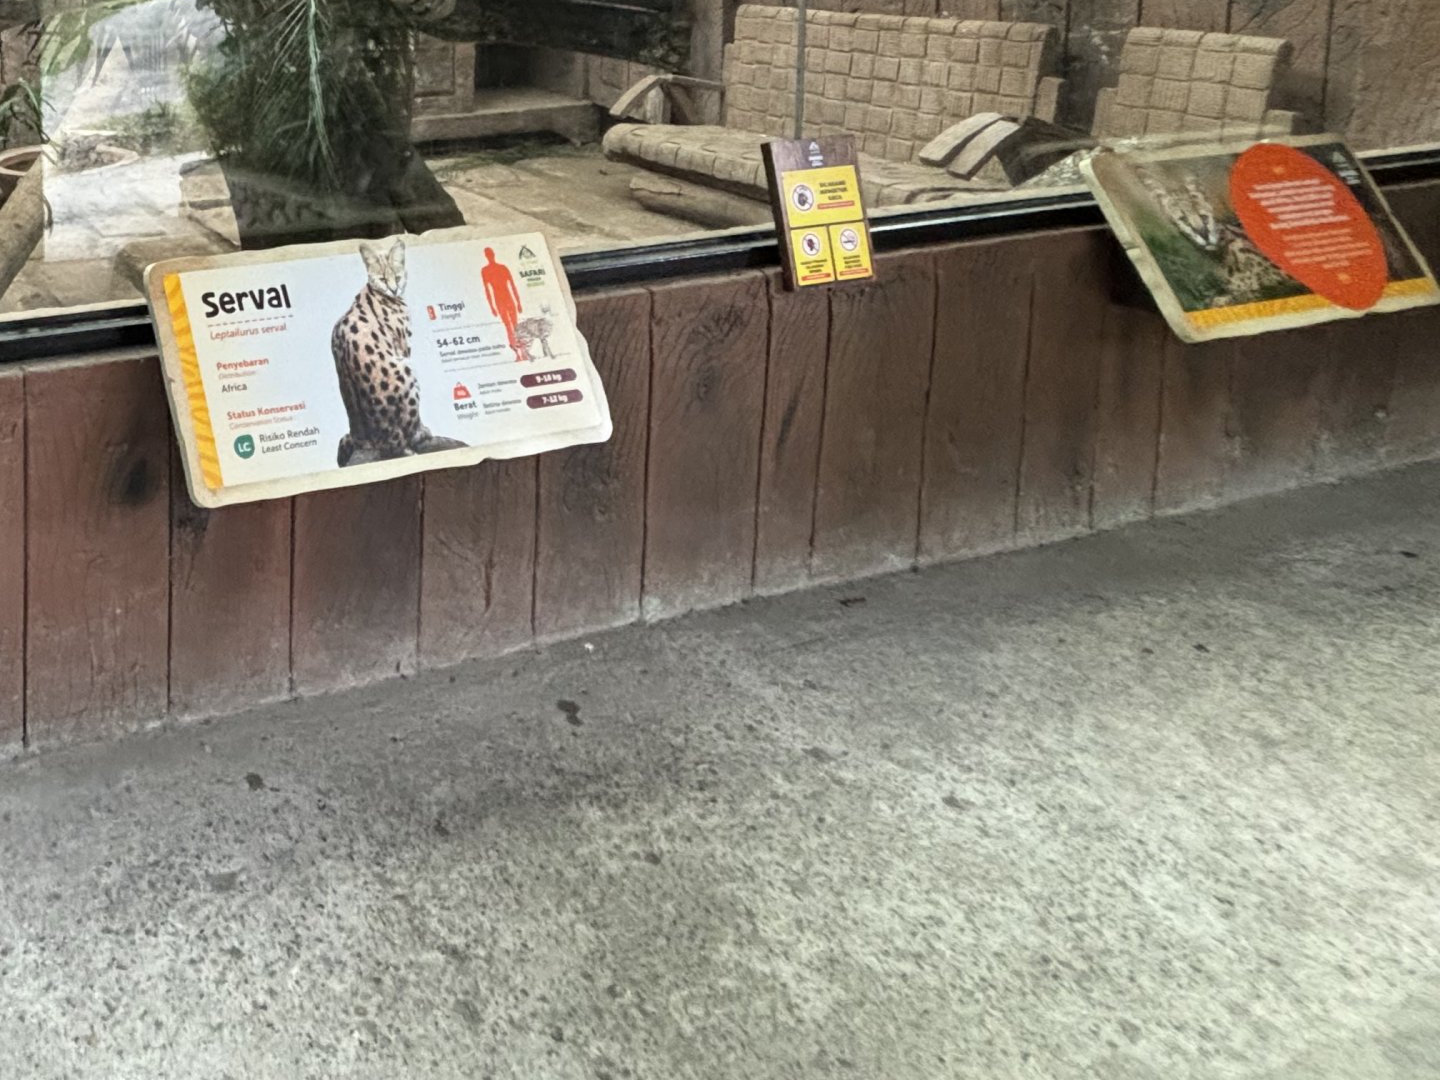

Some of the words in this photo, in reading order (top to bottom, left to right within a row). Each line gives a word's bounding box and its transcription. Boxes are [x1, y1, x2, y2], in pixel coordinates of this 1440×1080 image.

[201, 284, 292, 318] Serval
[438, 301, 466, 311] Tinggi
[210, 326, 259, 341] Leptailurus
[261, 322, 288, 334] serval
[436, 336, 465, 348] 54-62
[466, 336, 481, 344] cm
[216, 358, 270, 371] Penyebaran
[221, 383, 248, 393] Africa
[227, 410, 256, 420] Status
[257, 401, 306, 415] Konservasi
[454, 400, 477, 411] Berat
[259, 433, 286, 443] Risiko
[287, 426, 320, 438] Rendah
[237, 442, 252, 453] LC
[262, 444, 283, 454] Least
[283, 439, 318, 450] Concern
